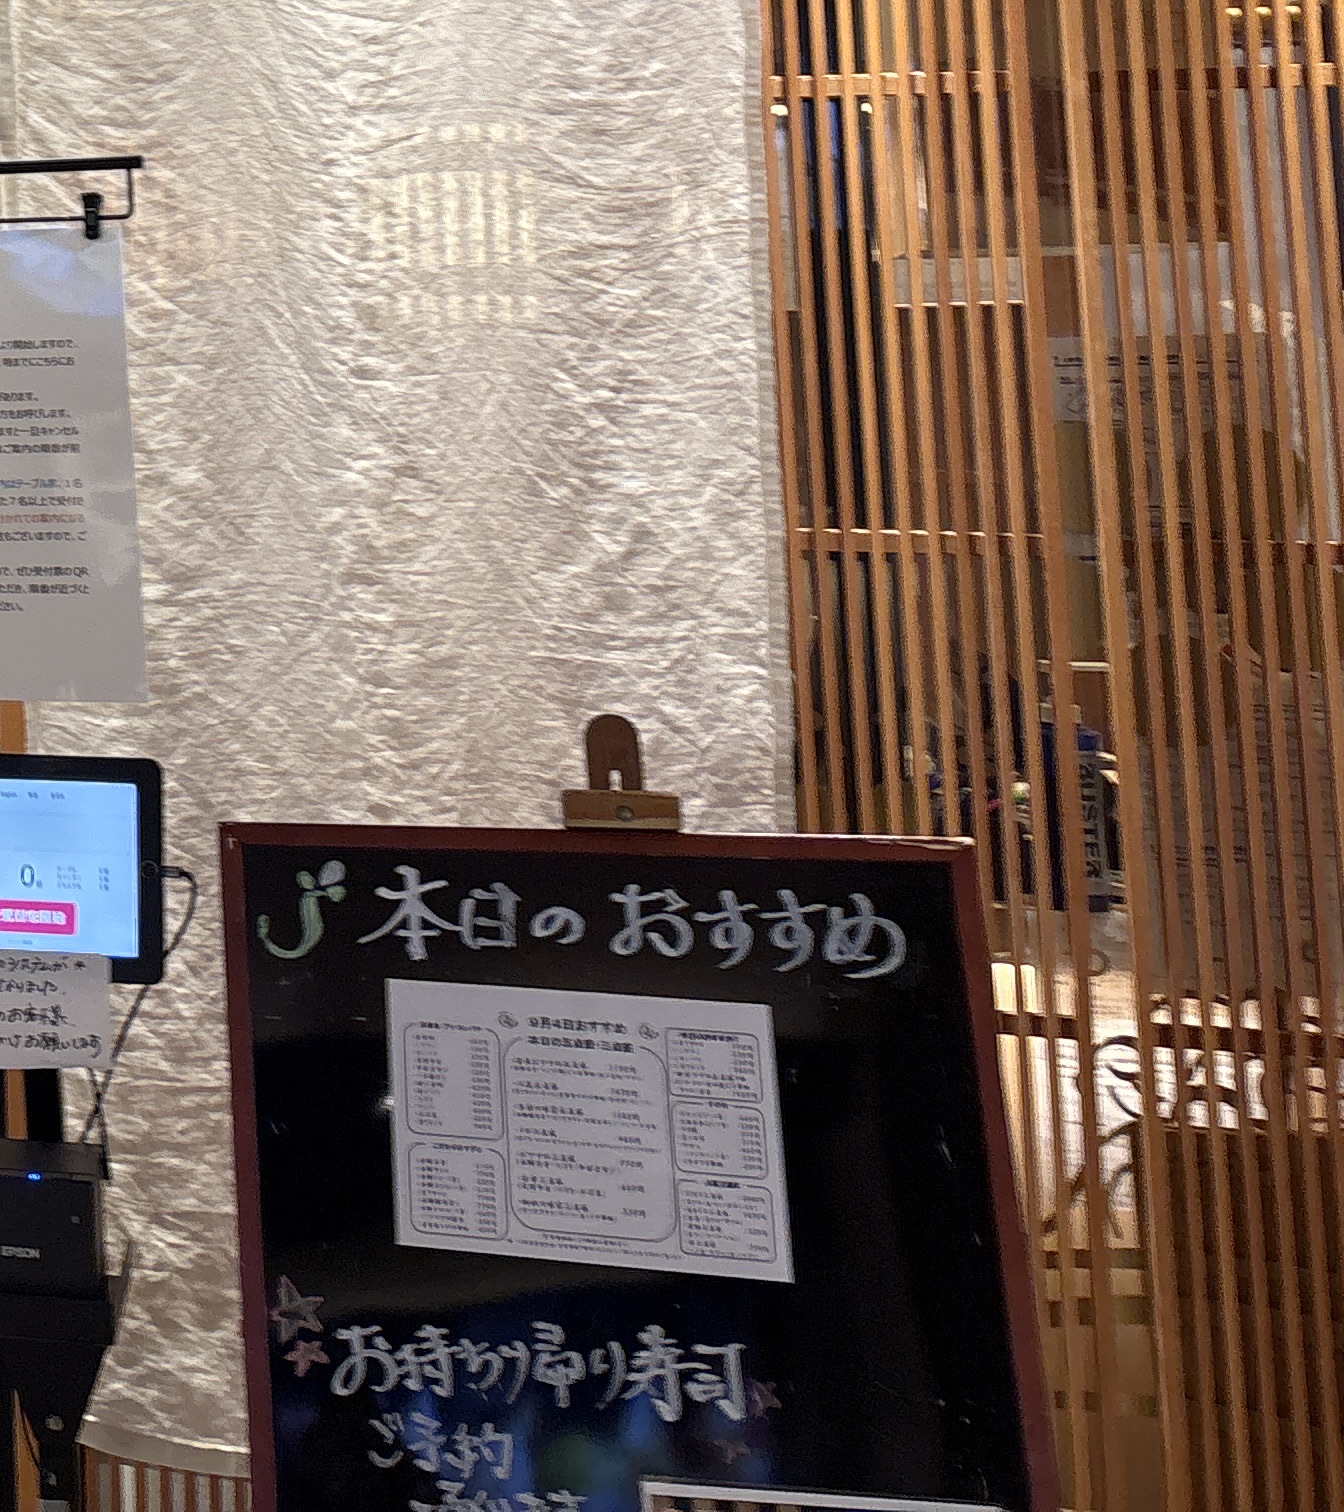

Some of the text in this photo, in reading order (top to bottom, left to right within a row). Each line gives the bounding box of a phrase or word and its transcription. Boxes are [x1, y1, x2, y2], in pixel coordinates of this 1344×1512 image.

[356, 864, 907, 980] 本日のおすすめ
[329, 1321, 750, 1423] お持ち帰り寿司
[367, 1411, 513, 1480] ご予約
